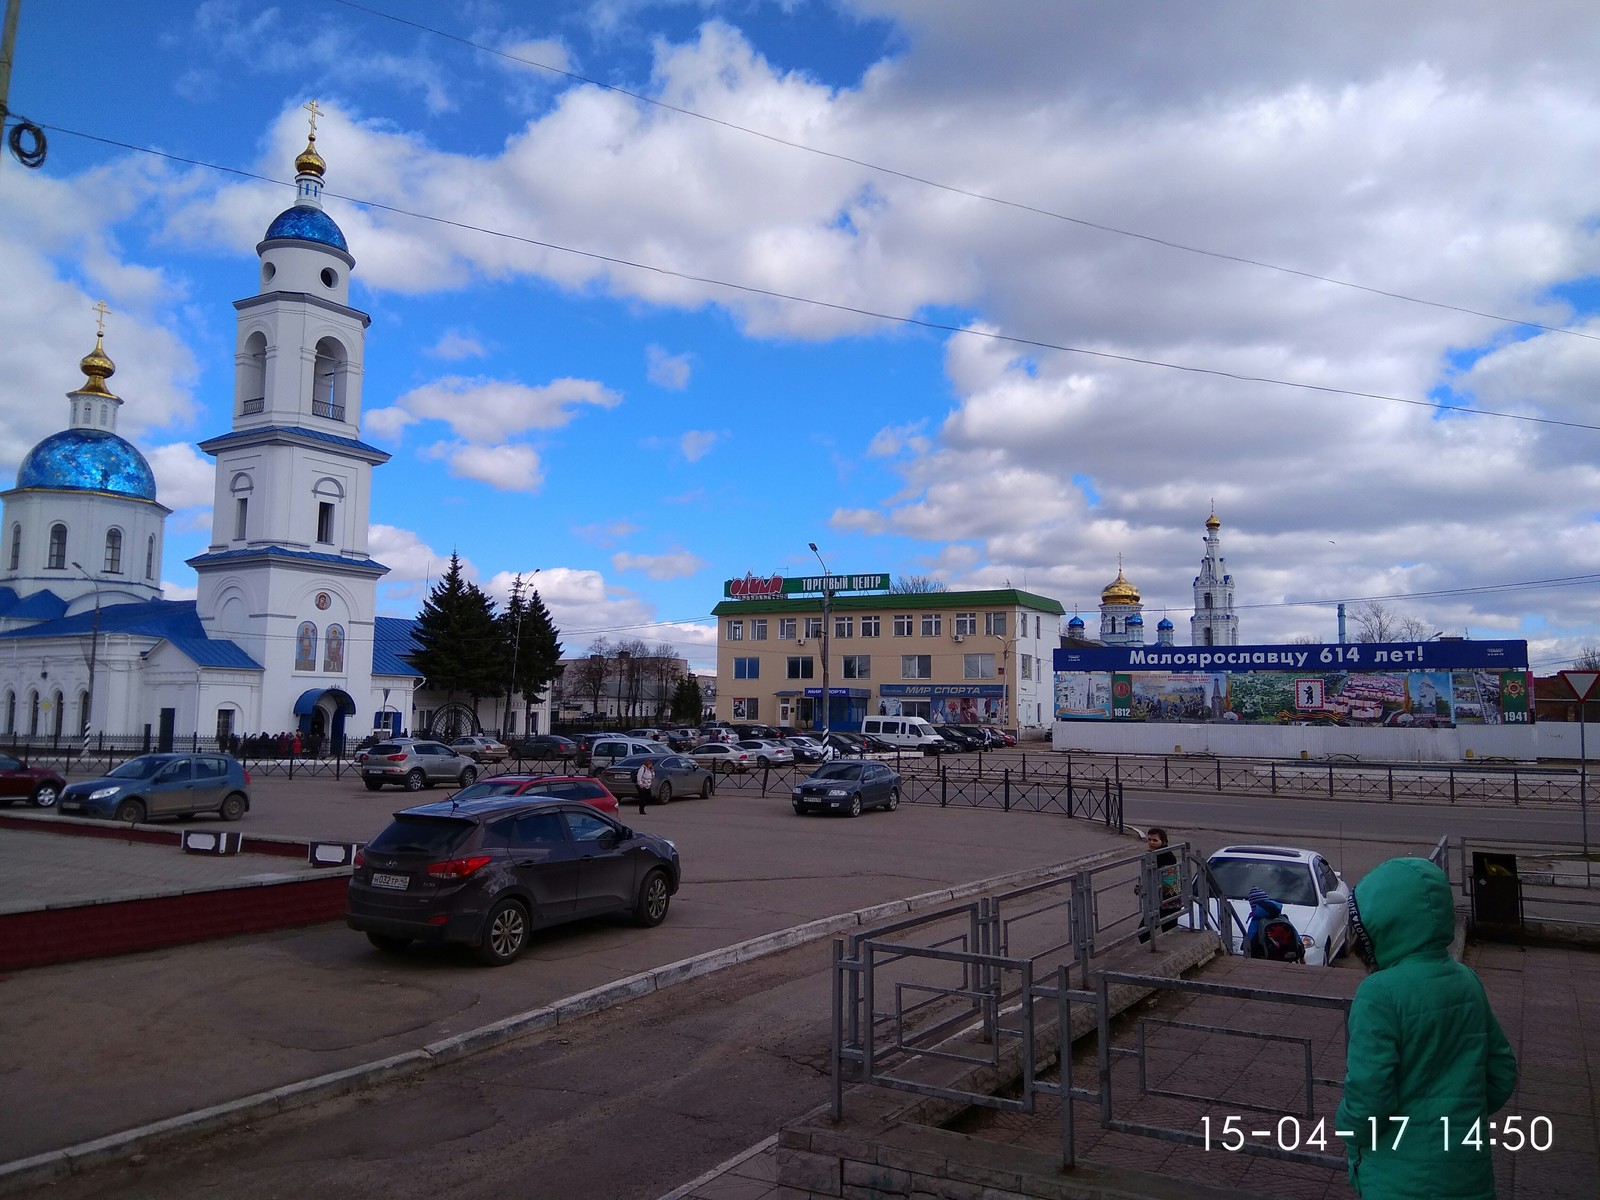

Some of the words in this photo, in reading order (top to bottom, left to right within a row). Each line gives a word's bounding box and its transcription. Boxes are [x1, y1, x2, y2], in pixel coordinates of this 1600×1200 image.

[852, 576, 881, 590] ЦЕНТР
[1129, 650, 1308, 667] Малоярославцу
[1320, 647, 1360, 663] 614
[1374, 645, 1424, 662] лет!
[905, 686, 931, 694] МИР
[934, 686, 980, 694] СПОРТА
[1113, 707, 1130, 717] 1812
[1503, 711, 1528, 721] 1941
[1347, 900, 1358, 916] LOVE
[1353, 923, 1369, 941] LOVE
